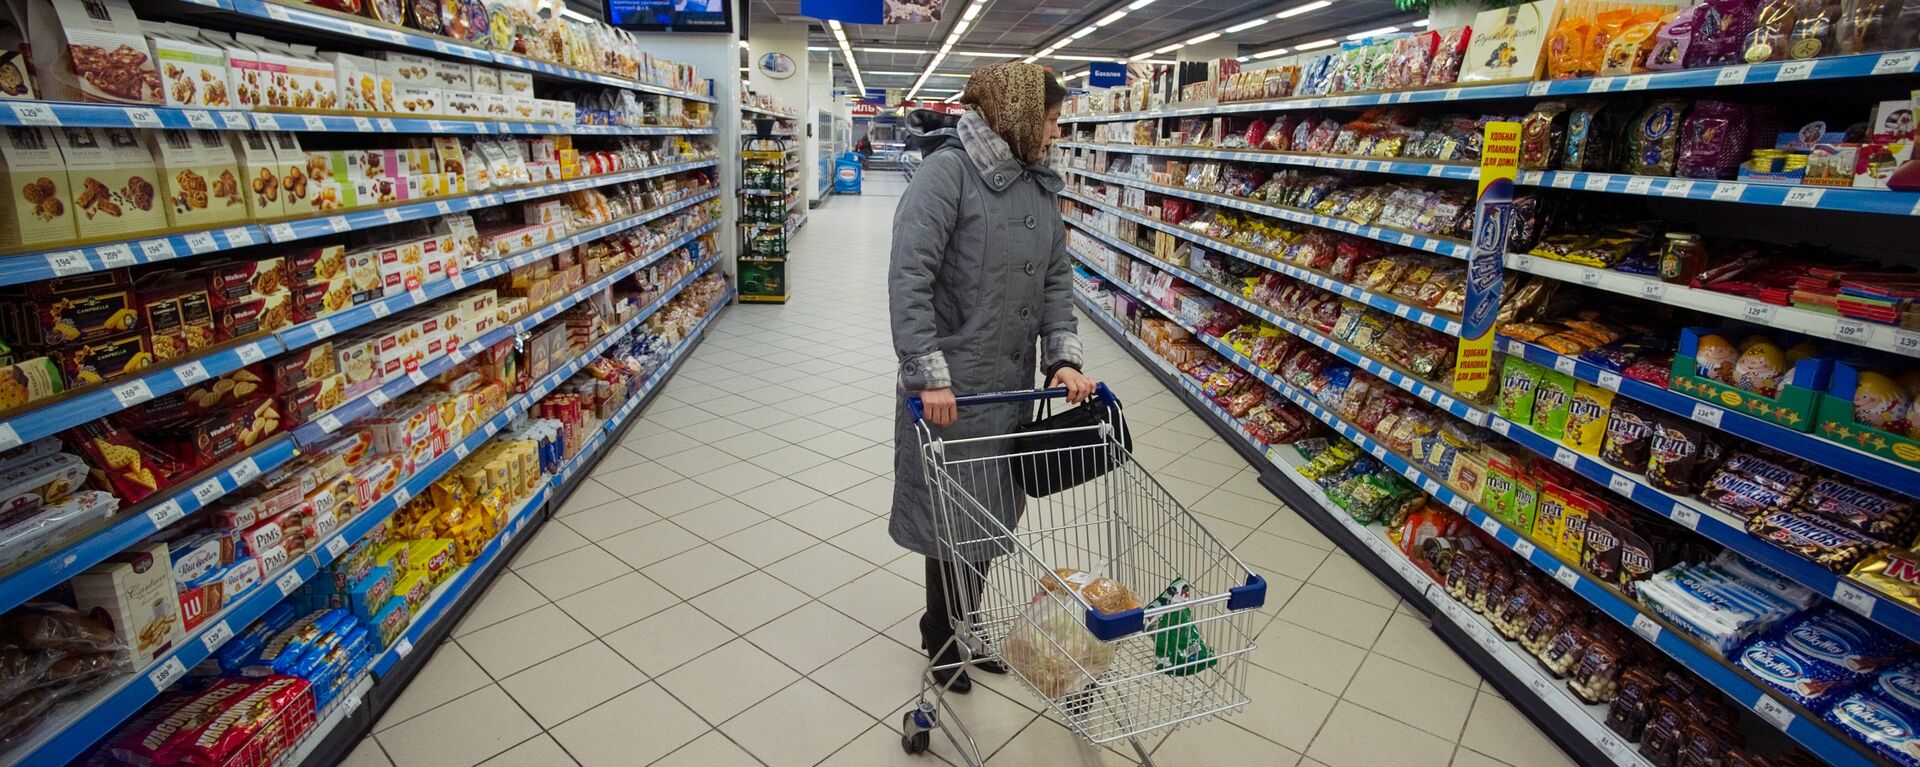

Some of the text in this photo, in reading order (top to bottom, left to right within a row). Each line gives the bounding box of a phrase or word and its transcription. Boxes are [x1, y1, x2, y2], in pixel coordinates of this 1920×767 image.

[1490, 132, 1517, 141] УДОБНАЯ
[1487, 145, 1516, 153] УПАКОВКА
[1463, 349, 1488, 357] УДОБНАЯ
[1460, 361, 1487, 369] УПАКОВКА
[1718, 475, 1779, 504] SNICKERS
[1815, 481, 1892, 514] SNICKERS
[256, 528, 280, 548] PiM's
[1769, 513, 1845, 548] SNICKERS
[264, 549, 286, 570] PiM's
[184, 596, 202, 620] LU
